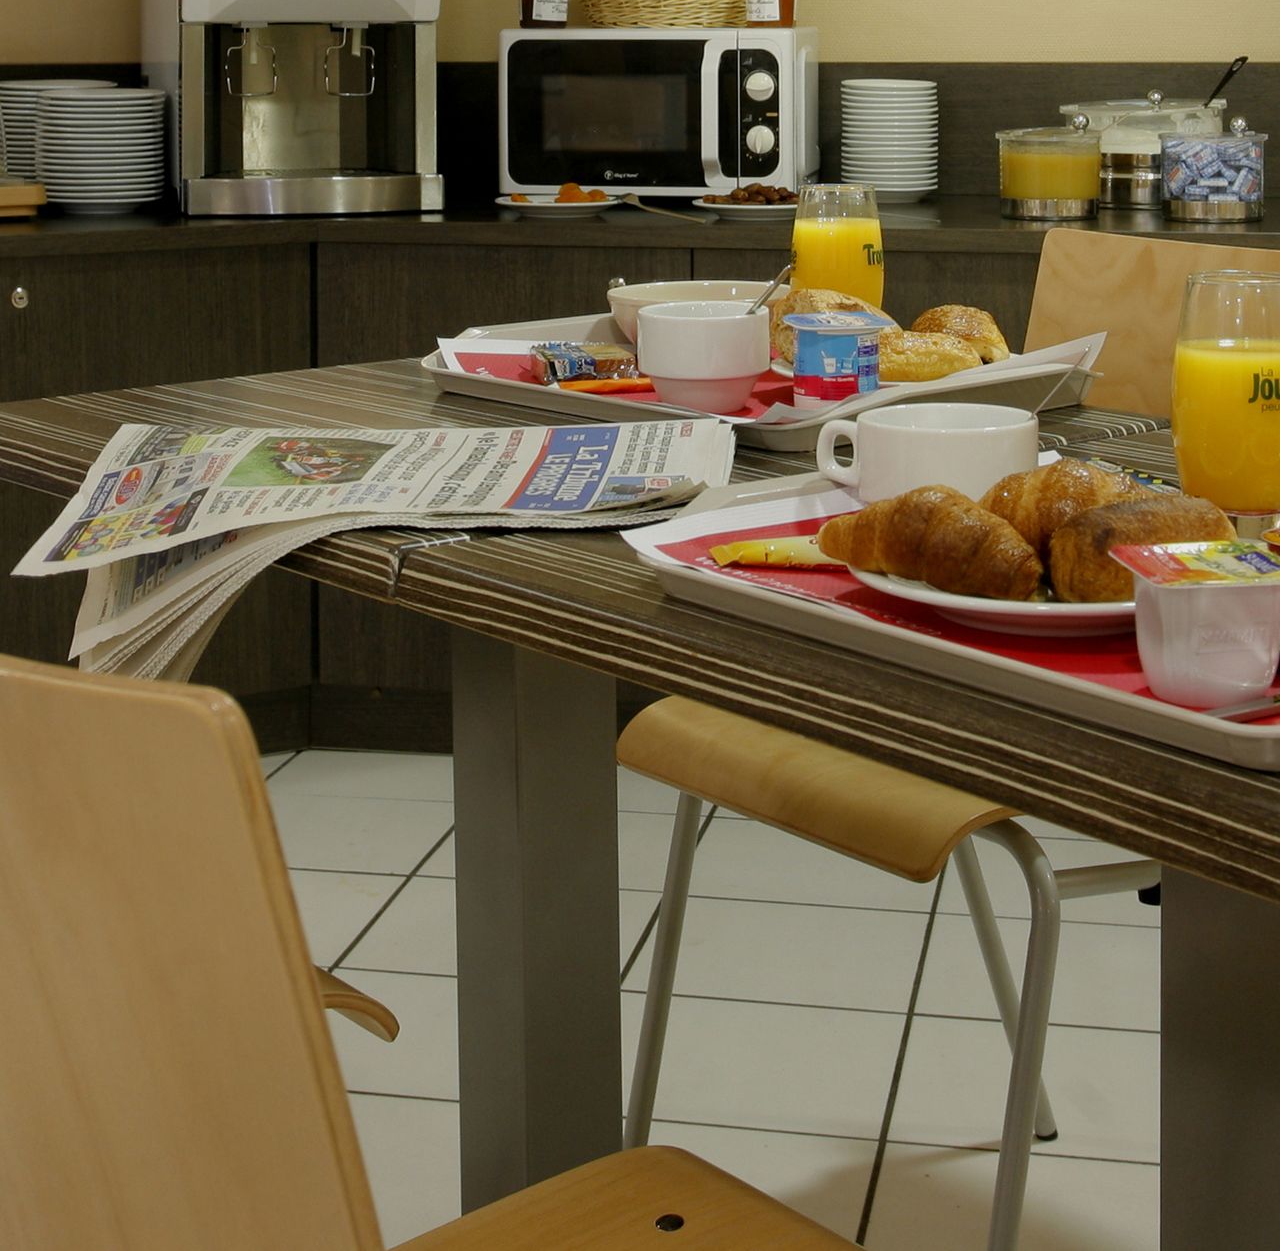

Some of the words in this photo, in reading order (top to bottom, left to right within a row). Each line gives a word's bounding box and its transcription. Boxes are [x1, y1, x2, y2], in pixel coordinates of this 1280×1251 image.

[1261, 366, 1274, 378] La
[575, 445, 609, 460] La
[553, 459, 604, 502] Tribune
